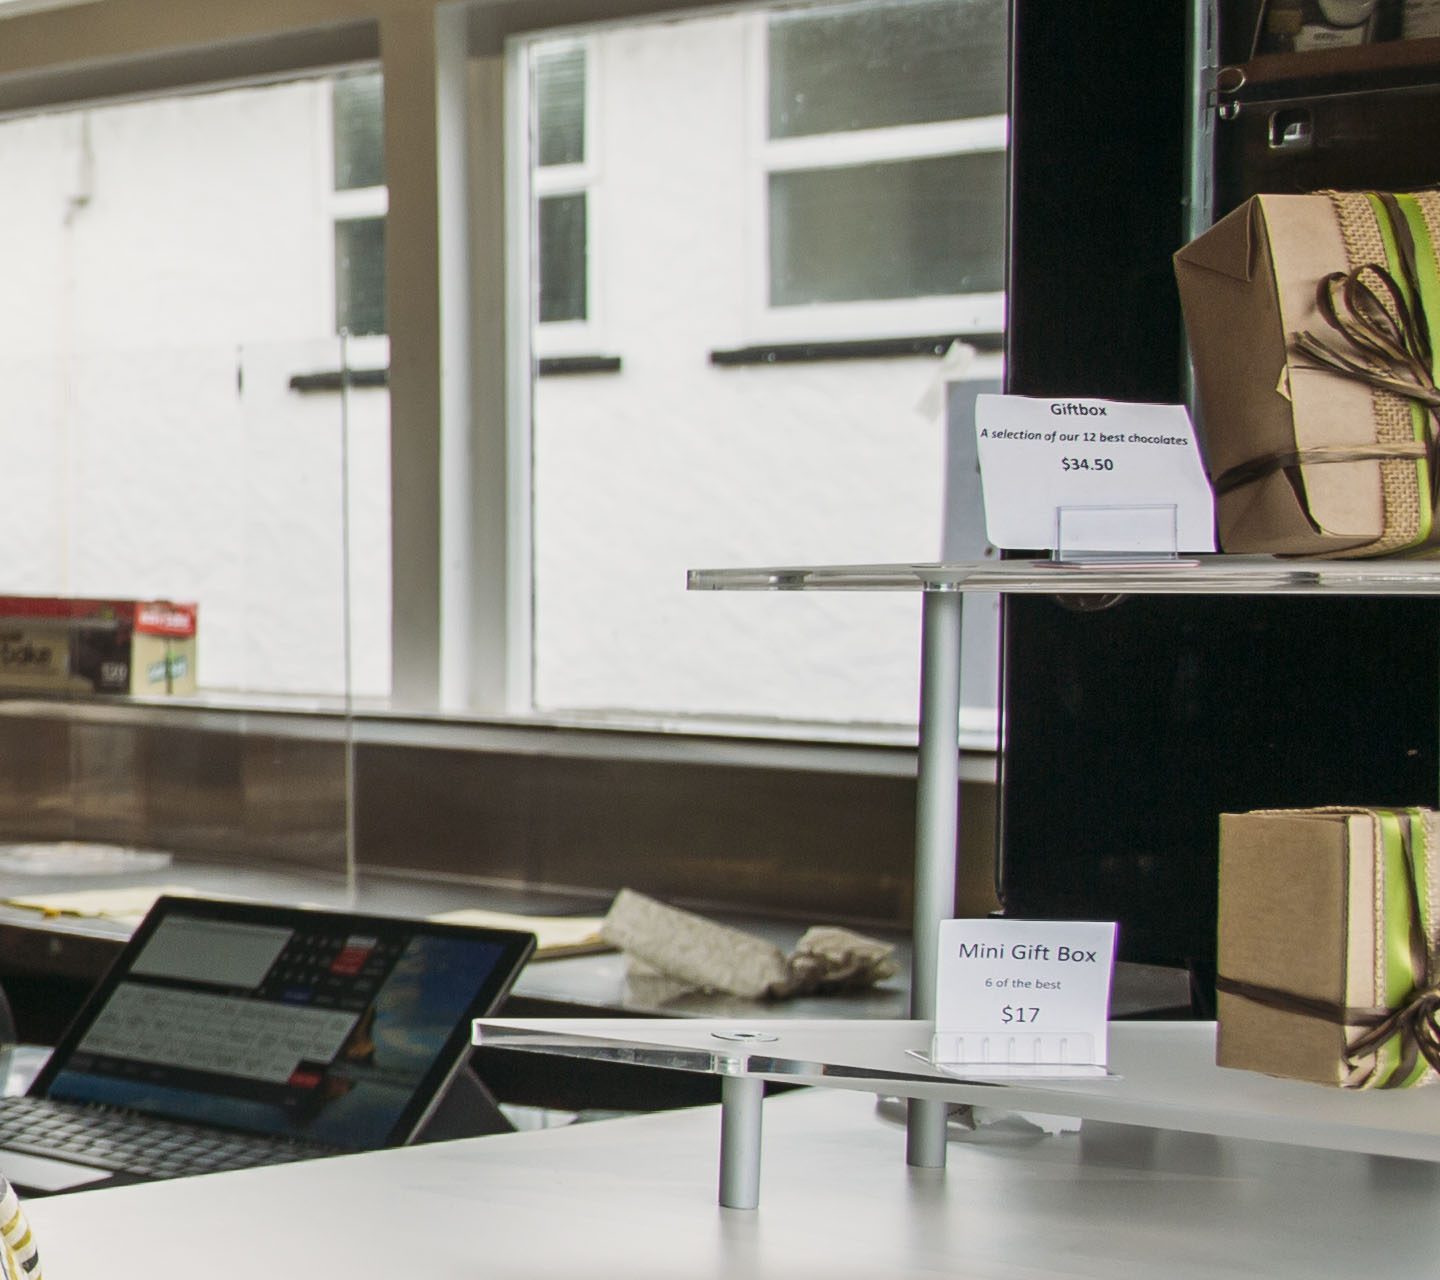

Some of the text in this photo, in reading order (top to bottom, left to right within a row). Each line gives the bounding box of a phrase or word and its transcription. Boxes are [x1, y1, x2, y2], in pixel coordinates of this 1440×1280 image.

[1050, 402, 1107, 417] Giftbox
[980, 428, 1188, 446] A selection of our 12 best chocolates
[1061, 456, 1114, 472] $34.50
[959, 943, 1097, 963] Mini Gift Box
[985, 977, 1061, 990] 6 of the best
[1001, 1004, 1040, 1024] $17
